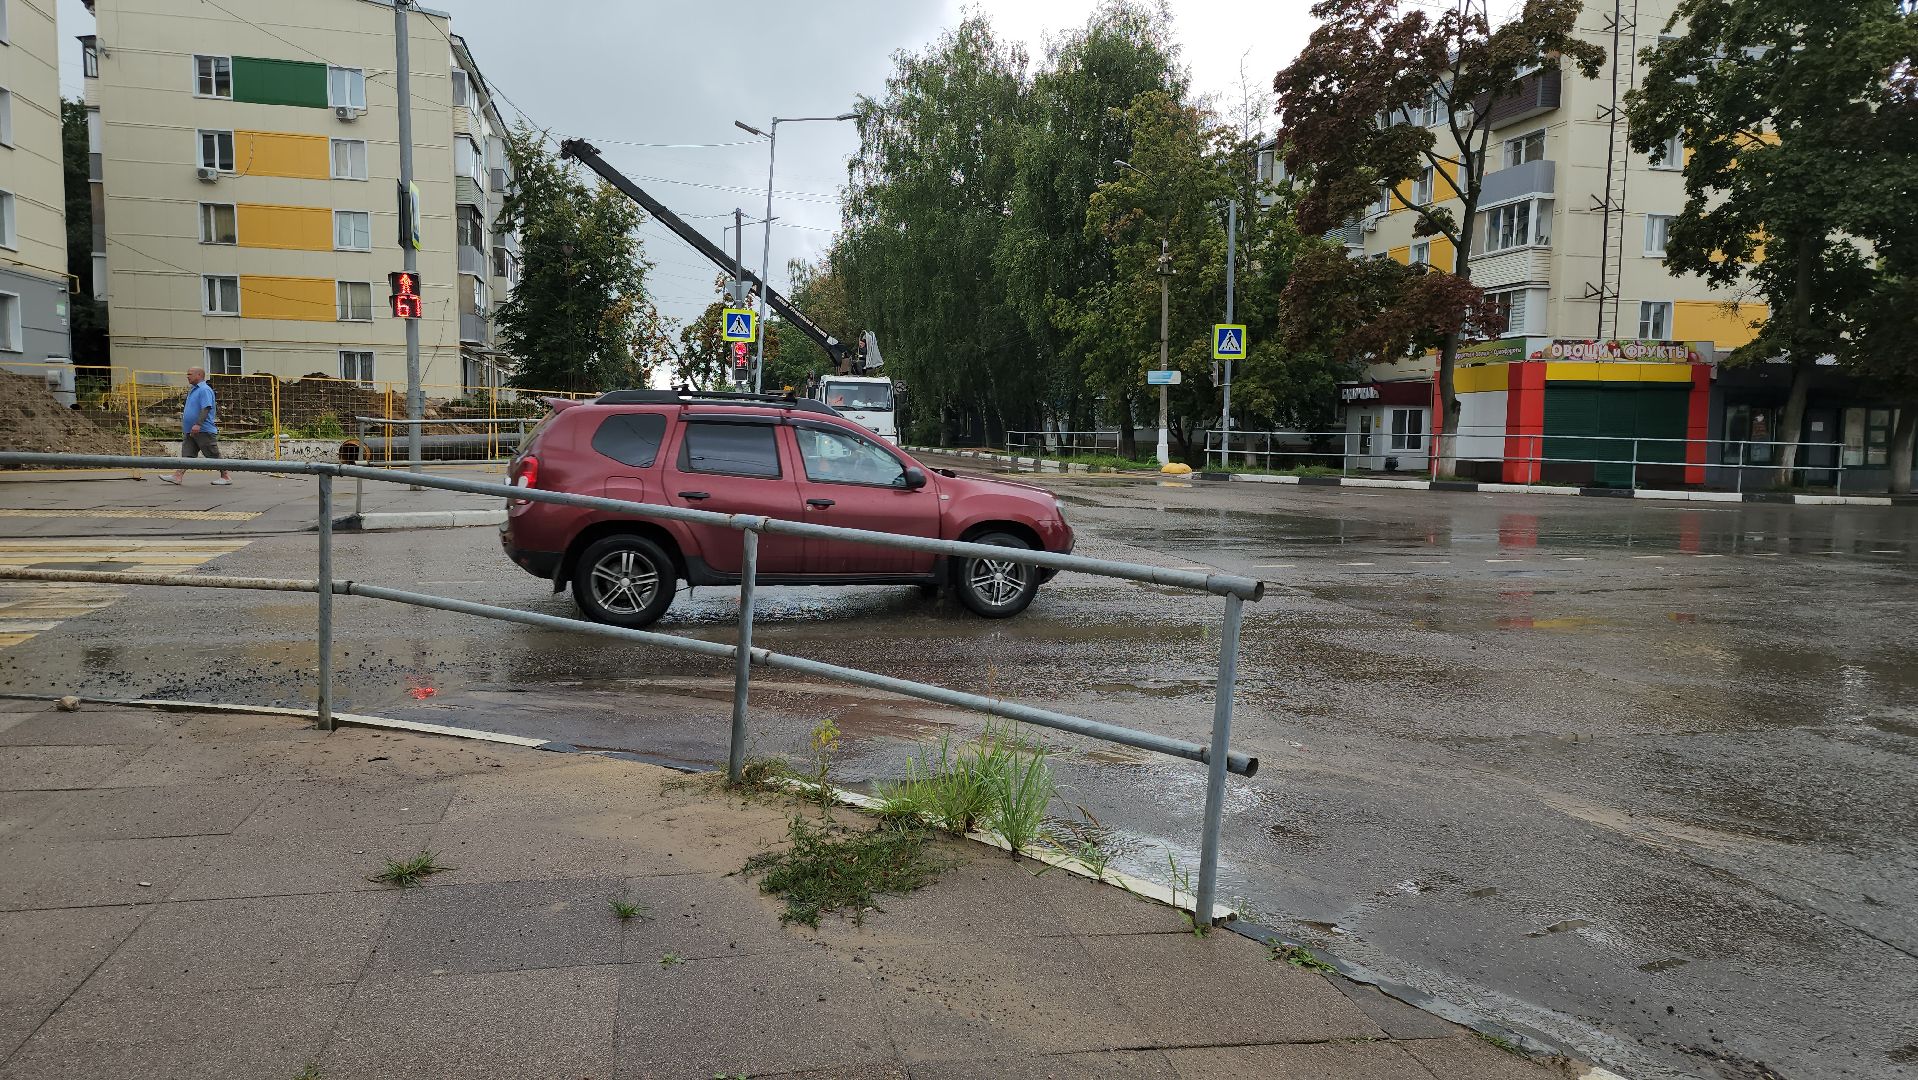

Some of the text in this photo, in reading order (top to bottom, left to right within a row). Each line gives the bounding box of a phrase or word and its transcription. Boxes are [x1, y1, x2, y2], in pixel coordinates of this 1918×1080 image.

[397, 295, 422, 318] 67
[1551, 342, 1689, 359] ОВОЩИ и ФРУКТЫ
